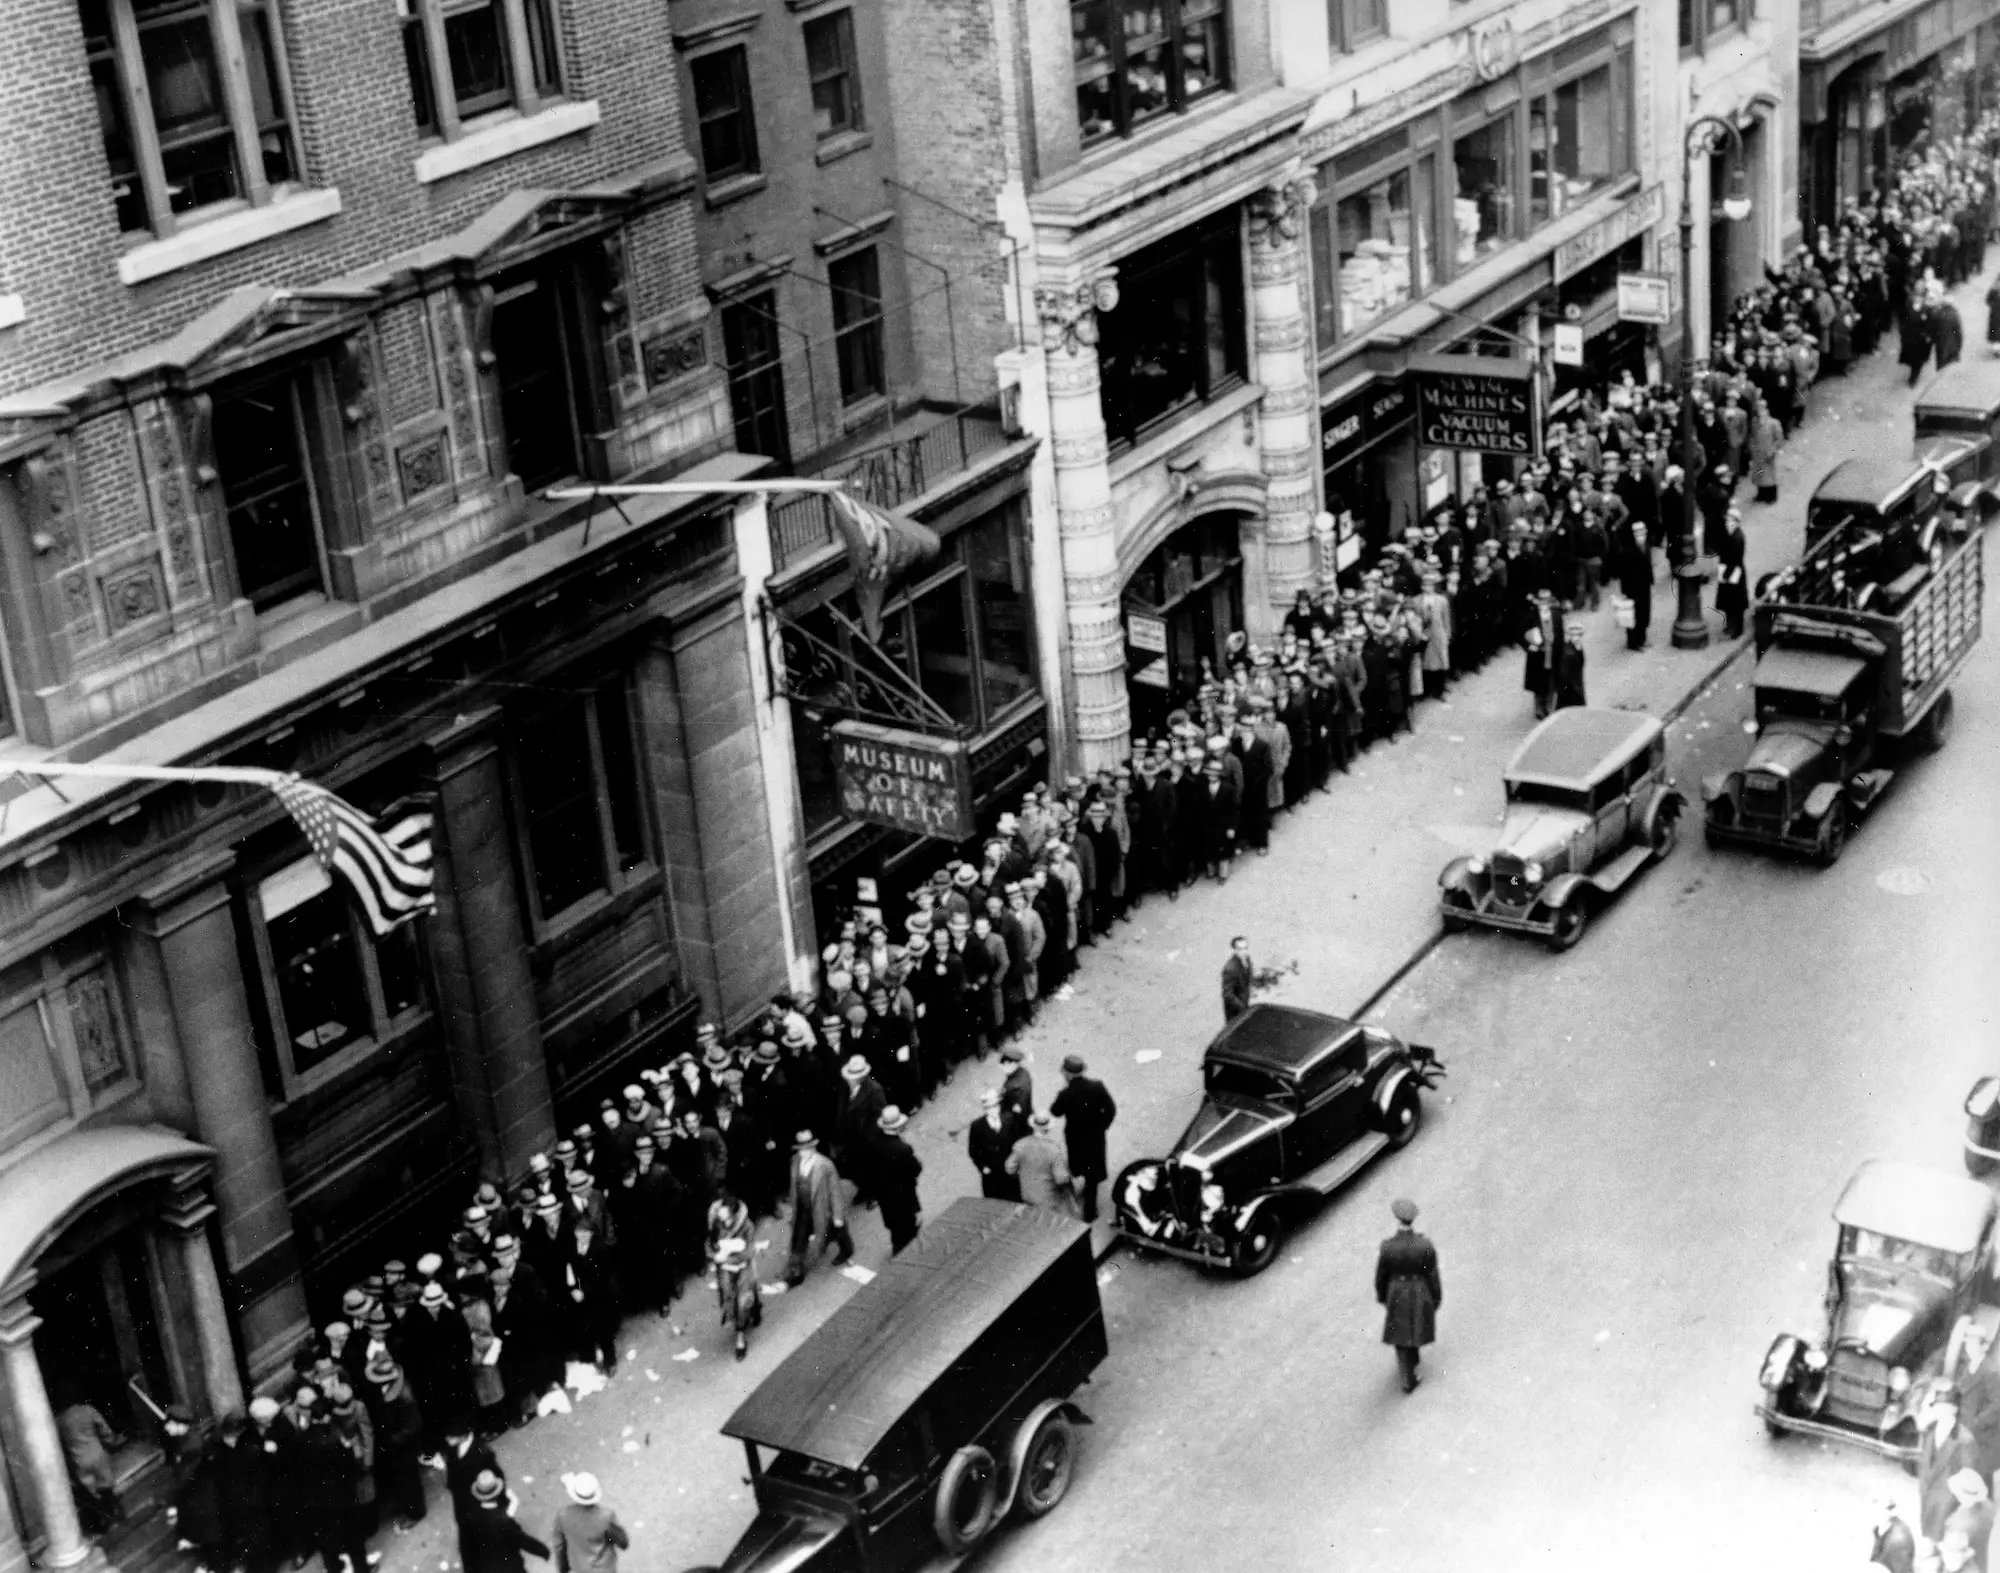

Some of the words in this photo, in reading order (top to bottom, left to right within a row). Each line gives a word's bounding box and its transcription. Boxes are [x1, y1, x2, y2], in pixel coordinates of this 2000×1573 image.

[1440, 378, 1509, 395] SEWING
[1424, 388, 1526, 413] MACHINES
[1439, 412, 1510, 433] VACUUM
[1428, 424, 1528, 451] CLEANERS
[843, 744, 946, 782] MUSEUM
[875, 773, 911, 796] OF
